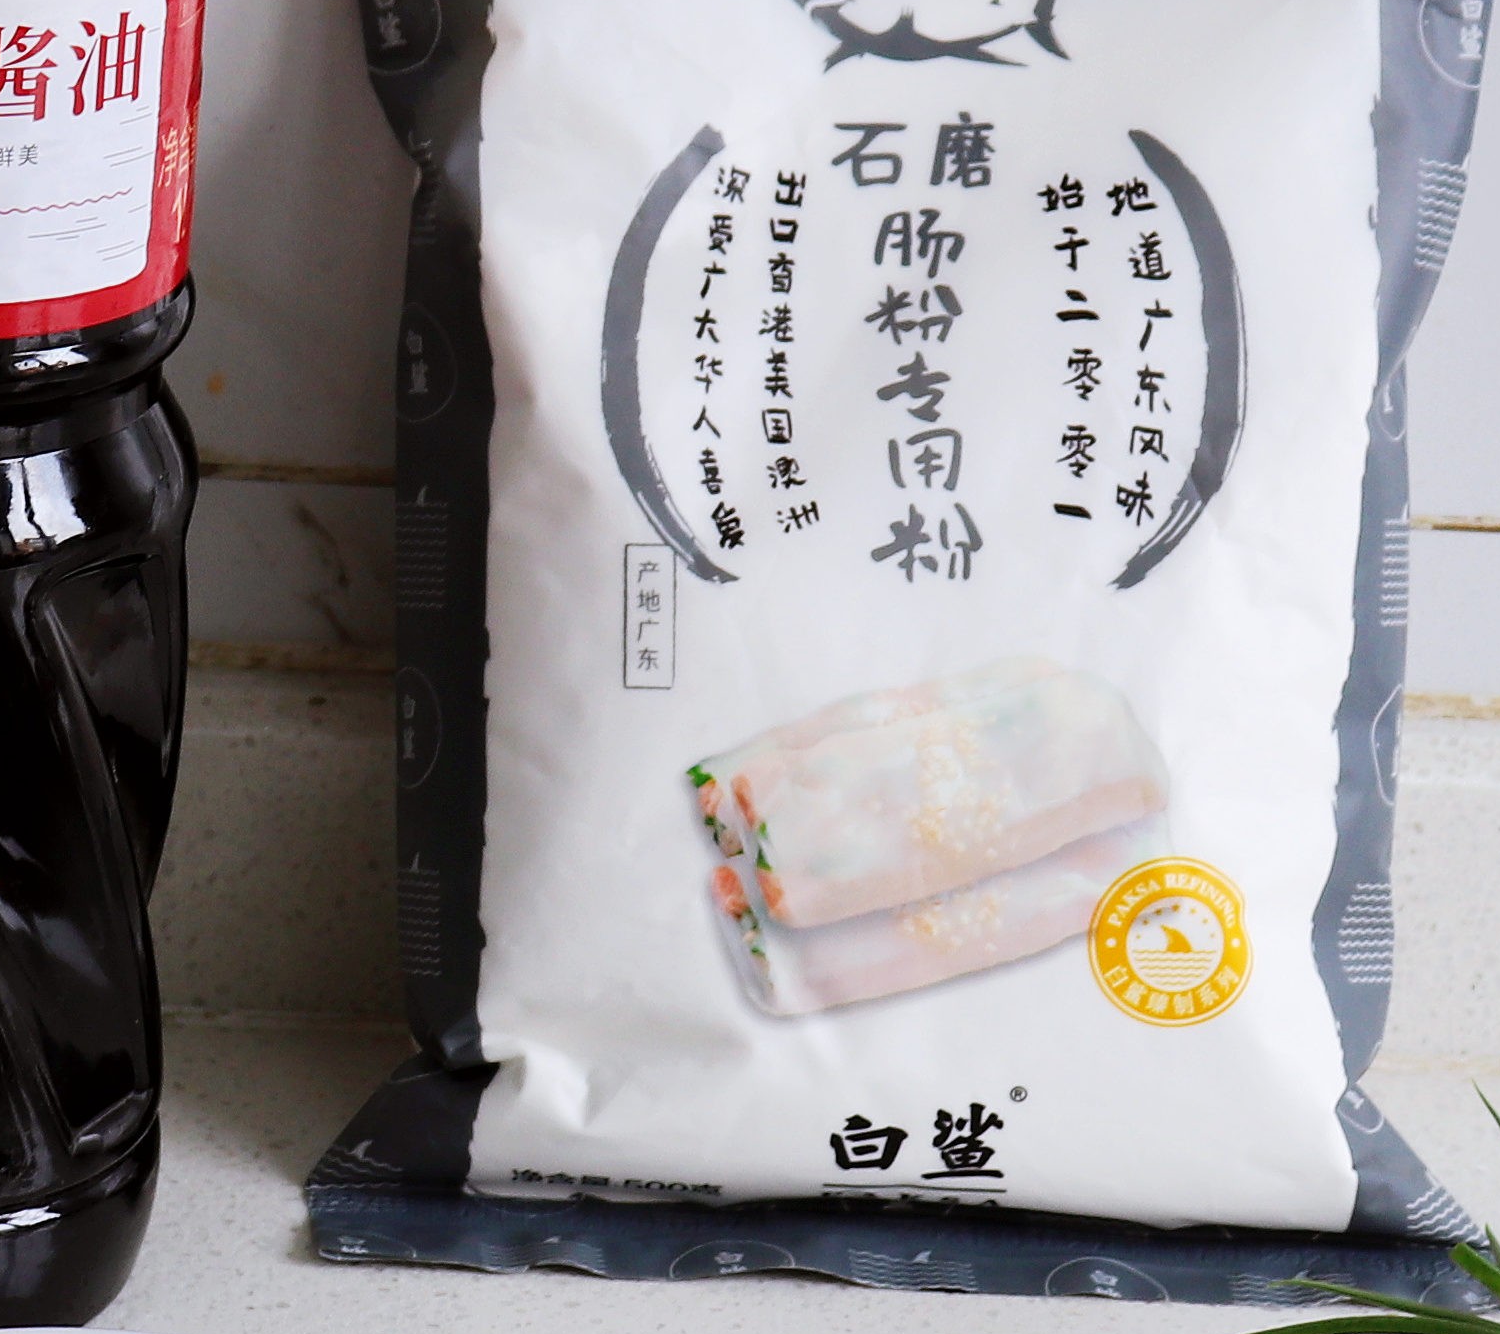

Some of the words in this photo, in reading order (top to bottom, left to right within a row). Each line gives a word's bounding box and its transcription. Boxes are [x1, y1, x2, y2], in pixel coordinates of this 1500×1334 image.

[831, 111, 996, 188] 石磨
[693, 166, 751, 549] 深受广大华人喜爱
[758, 170, 821, 534] 出口香港美国澳洲
[863, 208, 984, 583] 肠粉专用粉
[1037, 173, 1102, 520] 始于二零零一
[1106, 177, 1173, 527] 地道广东风味
[637, 561, 661, 671] 产地广东
[829, 1102, 1004, 1180] 白鲨
